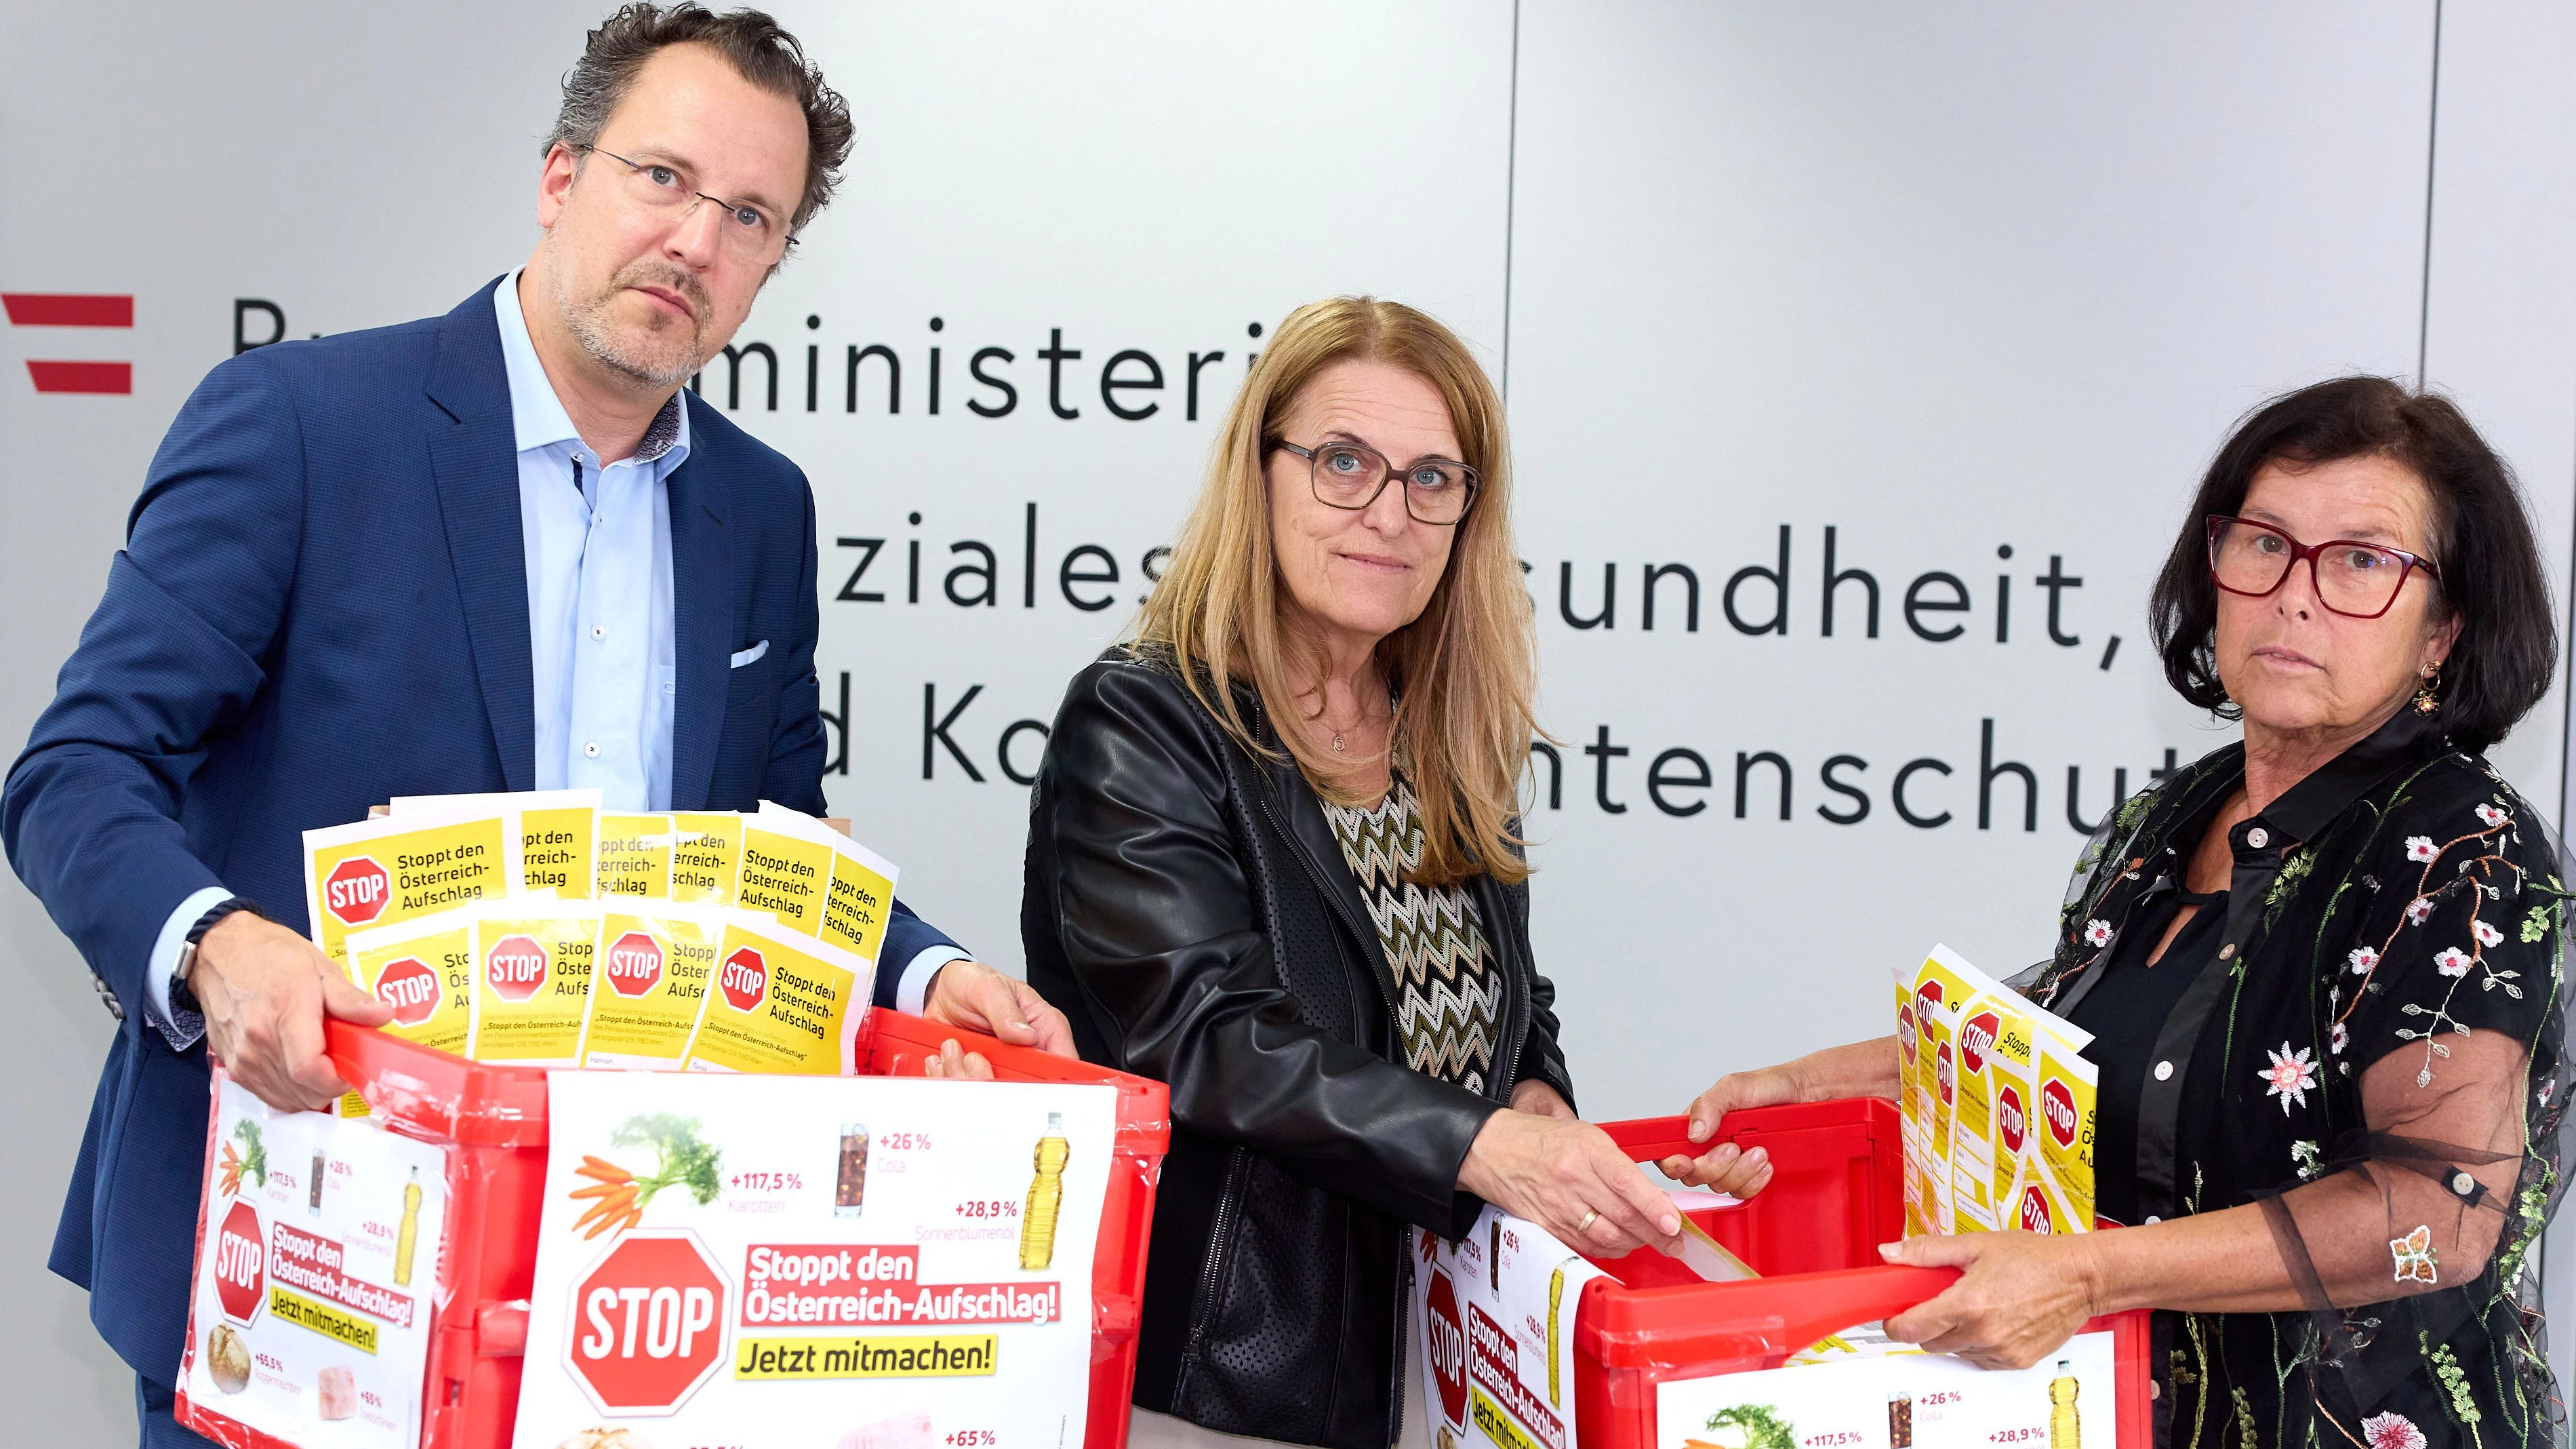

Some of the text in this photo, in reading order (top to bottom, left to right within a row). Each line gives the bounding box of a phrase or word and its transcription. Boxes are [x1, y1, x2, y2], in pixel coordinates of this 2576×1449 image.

[544, 830, 573, 844] den
[701, 833, 725, 849] den
[397, 844, 485, 869] Stoppt den
[523, 850, 576, 865] rreich-
[674, 852, 725, 869] erreich-
[745, 850, 815, 878] Stoppt den
[330, 873, 384, 909] STOP
[400, 862, 489, 890] Österreich-
[524, 871, 566, 887] chlag
[672, 871, 715, 891] schlag
[743, 865, 813, 897] Österreich-
[401, 885, 482, 911] Aufschlag
[740, 888, 803, 919] Aufschlag
[856, 888, 877, 908] den
[491, 954, 542, 982] STOP
[611, 949, 658, 980] STOP
[723, 961, 763, 997] STOP
[380, 973, 434, 1009] STOP
[776, 966, 836, 1001] Stoppt den
[772, 982, 834, 1019] Österreich-
[1917, 993, 1934, 1026] STO
[513, 1021, 526, 1029] den
[623, 1016, 636, 1025] den
[730, 1029, 742, 1039] den
[769, 1004, 825, 1040] Aufschlag
[1900, 1018, 1915, 1051] STOP
[1939, 1054, 1952, 1088] STO
[2000, 1100, 2024, 1138] STOP
[2045, 1090, 2075, 1134] STOP
[877, 1157, 906, 1174] Cola
[728, 1199, 786, 1214] Karotten
[2024, 1192, 2050, 1235] STOP
[273, 1224, 316, 1261] Stoppt
[316, 1240, 342, 1269] den
[915, 1225, 1015, 1242] Sonnenblumenöl
[218, 1230, 262, 1291] STOP
[748, 1246, 914, 1286] Stoppt den
[272, 1247, 412, 1327] Österreich-Aufschlag!
[745, 1280, 1056, 1326] Österreich-Aufschlag!
[272, 1290, 376, 1349] Jetzt mitmachen!
[580, 1286, 715, 1361] STOP
[740, 1338, 992, 1373] Jetzt mitmachen!
[1430, 1306, 1463, 1388] STOP
[1470, 1307, 1517, 1374] Stoppt den
[1473, 1392, 1495, 1435] Jetzt
[1919, 1410, 1944, 1424] Cola
